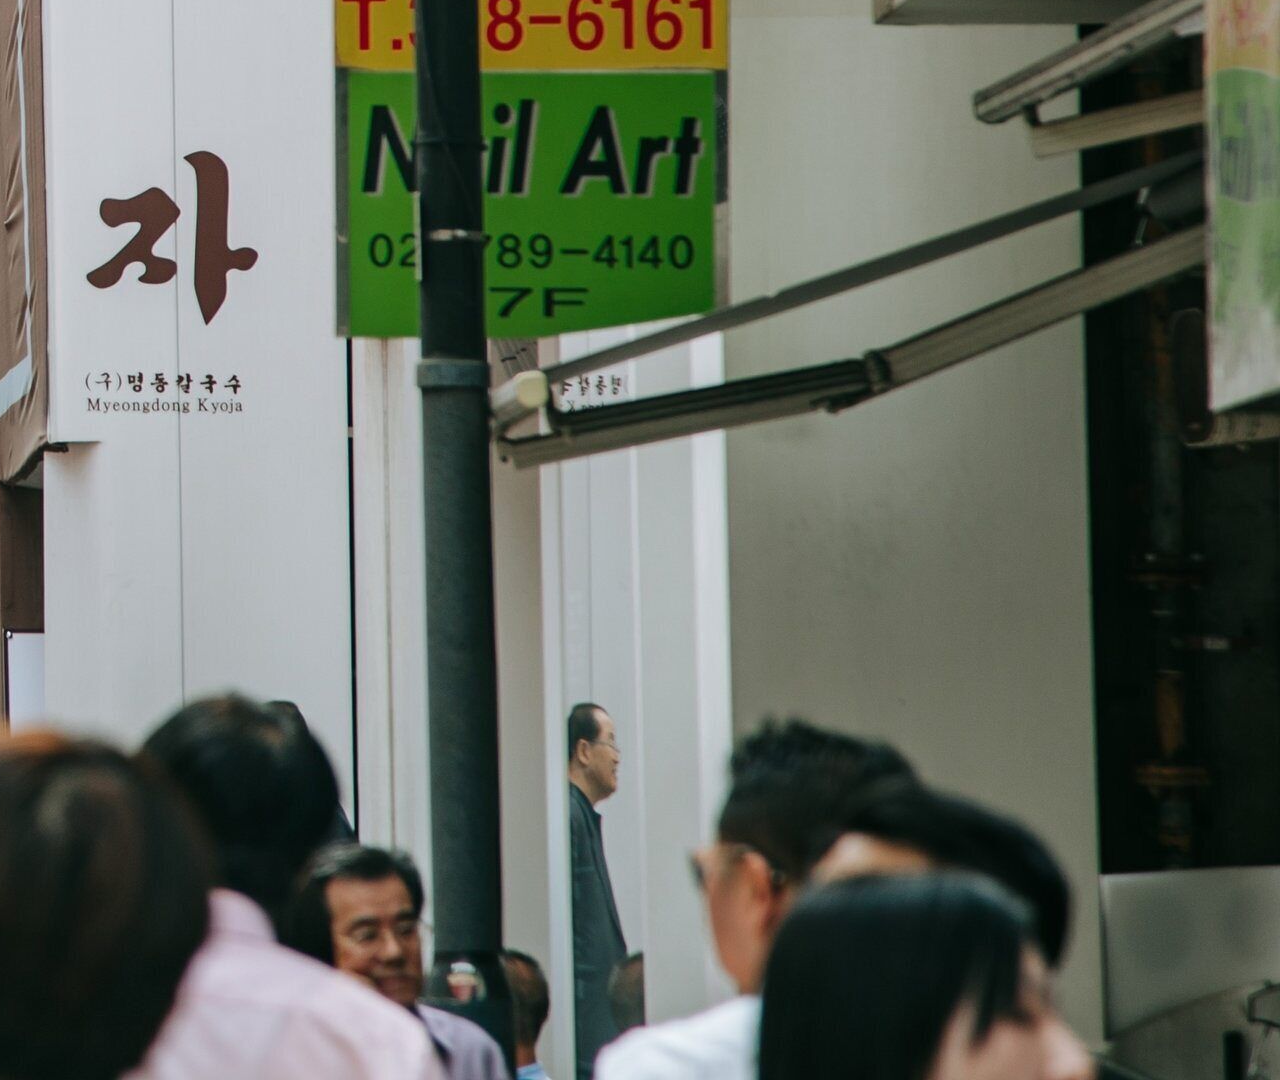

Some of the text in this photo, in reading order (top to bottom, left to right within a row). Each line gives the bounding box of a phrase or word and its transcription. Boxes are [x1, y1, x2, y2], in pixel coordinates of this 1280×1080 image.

[362, 99, 703, 197] Nil Art
[488, 287, 589, 319] 7F
[87, 397, 243, 414] Myeongdong Kyoja
